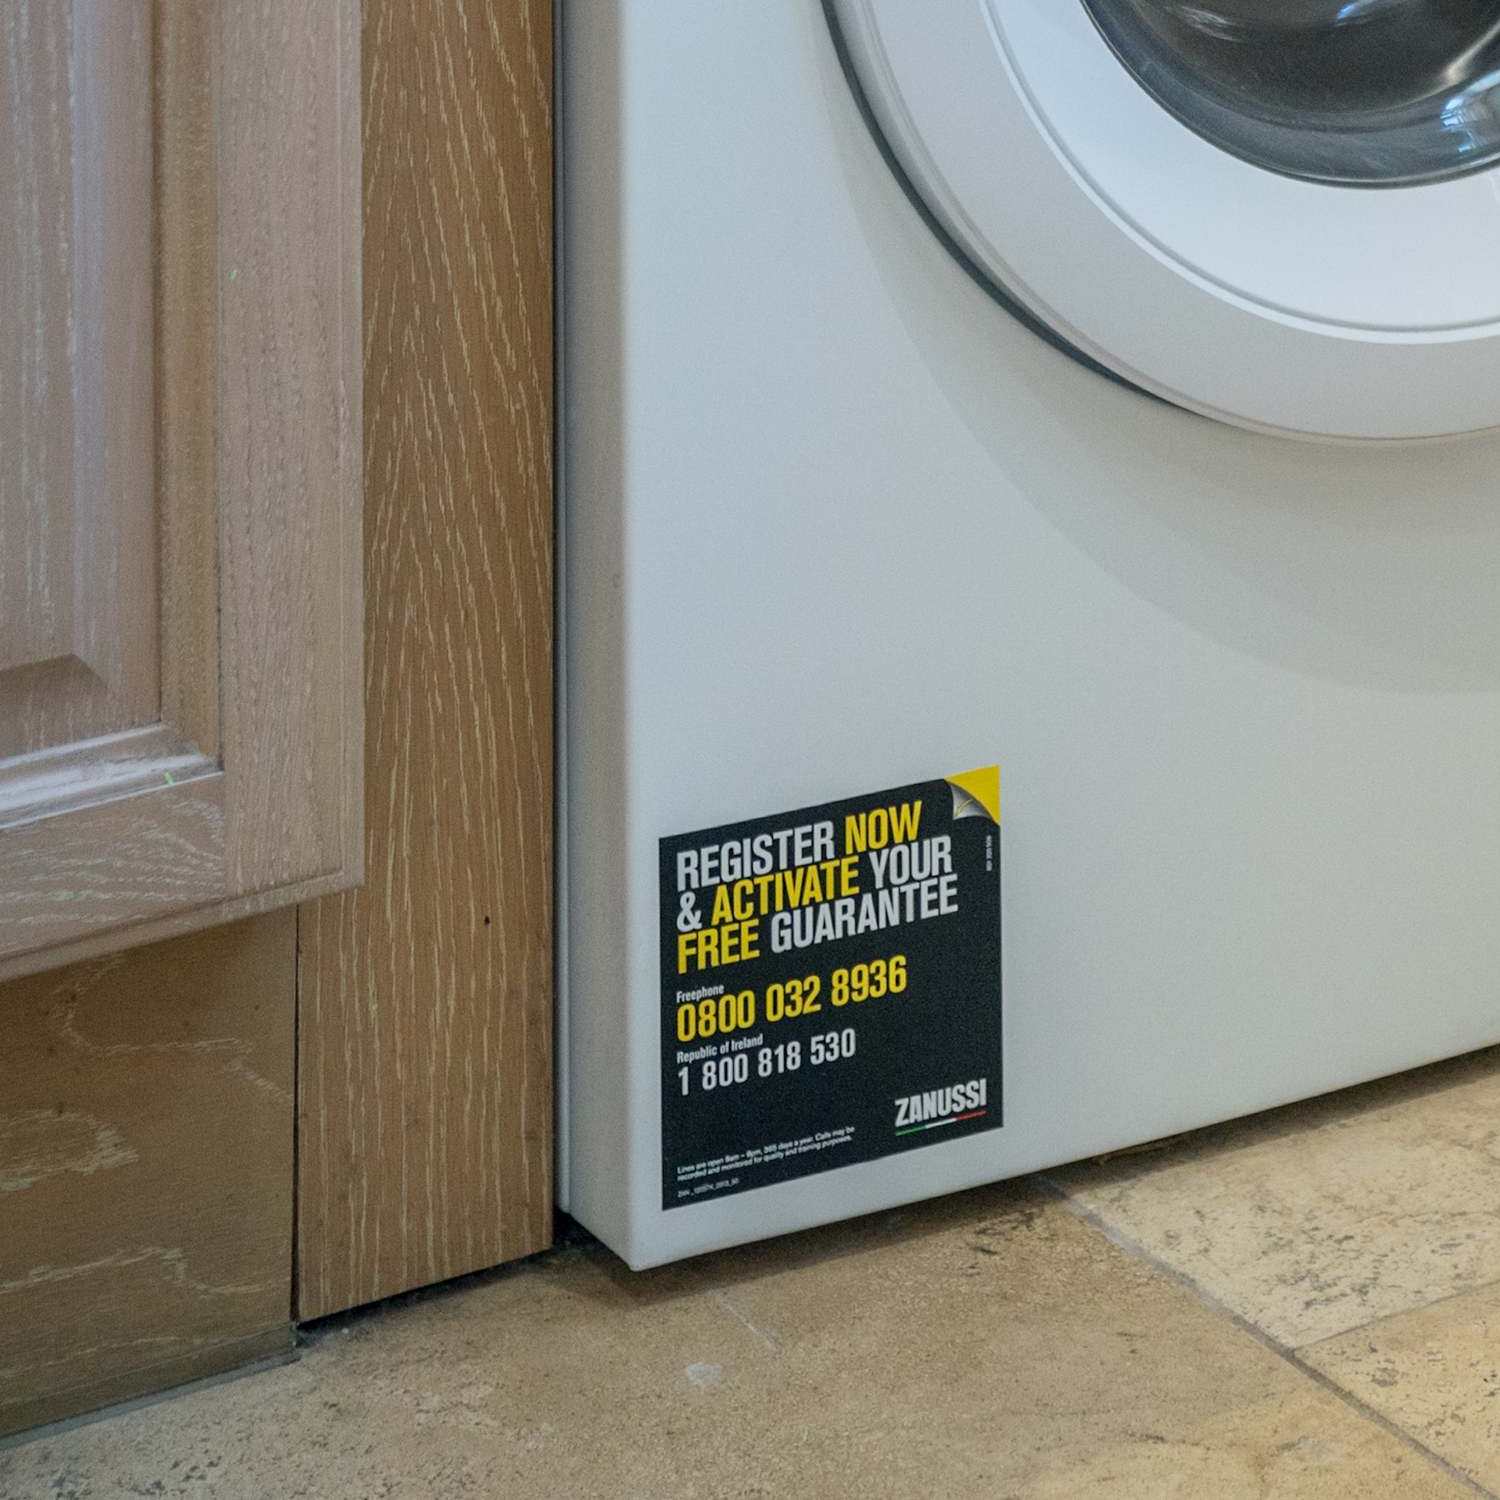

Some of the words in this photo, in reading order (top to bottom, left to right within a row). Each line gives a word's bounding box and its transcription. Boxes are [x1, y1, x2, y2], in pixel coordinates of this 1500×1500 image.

[676, 820, 834, 892] REGISTER
[844, 799, 922, 856] NOW
[676, 891, 702, 933] &
[711, 856, 860, 927] ACTIVATE
[869, 835, 953, 890] YOUR
[677, 918, 761, 975] FREE
[771, 873, 959, 954] GUARANTEE
[676, 984, 725, 1003] Freephone
[677, 990, 756, 1042] 0800
[766, 974, 822, 1023] 032
[831, 955, 907, 1007] 8936
[676, 1045, 718, 1064] Republic
[720, 1041, 730, 1054] of
[731, 1033, 764, 1051] Ireland
[678, 1066, 689, 1097] 1
[702, 1053, 749, 1091] 800
[758, 1041, 802, 1079] 818
[810, 1027, 856, 1066] 530
[895, 1078, 987, 1128] ZANUSSI
